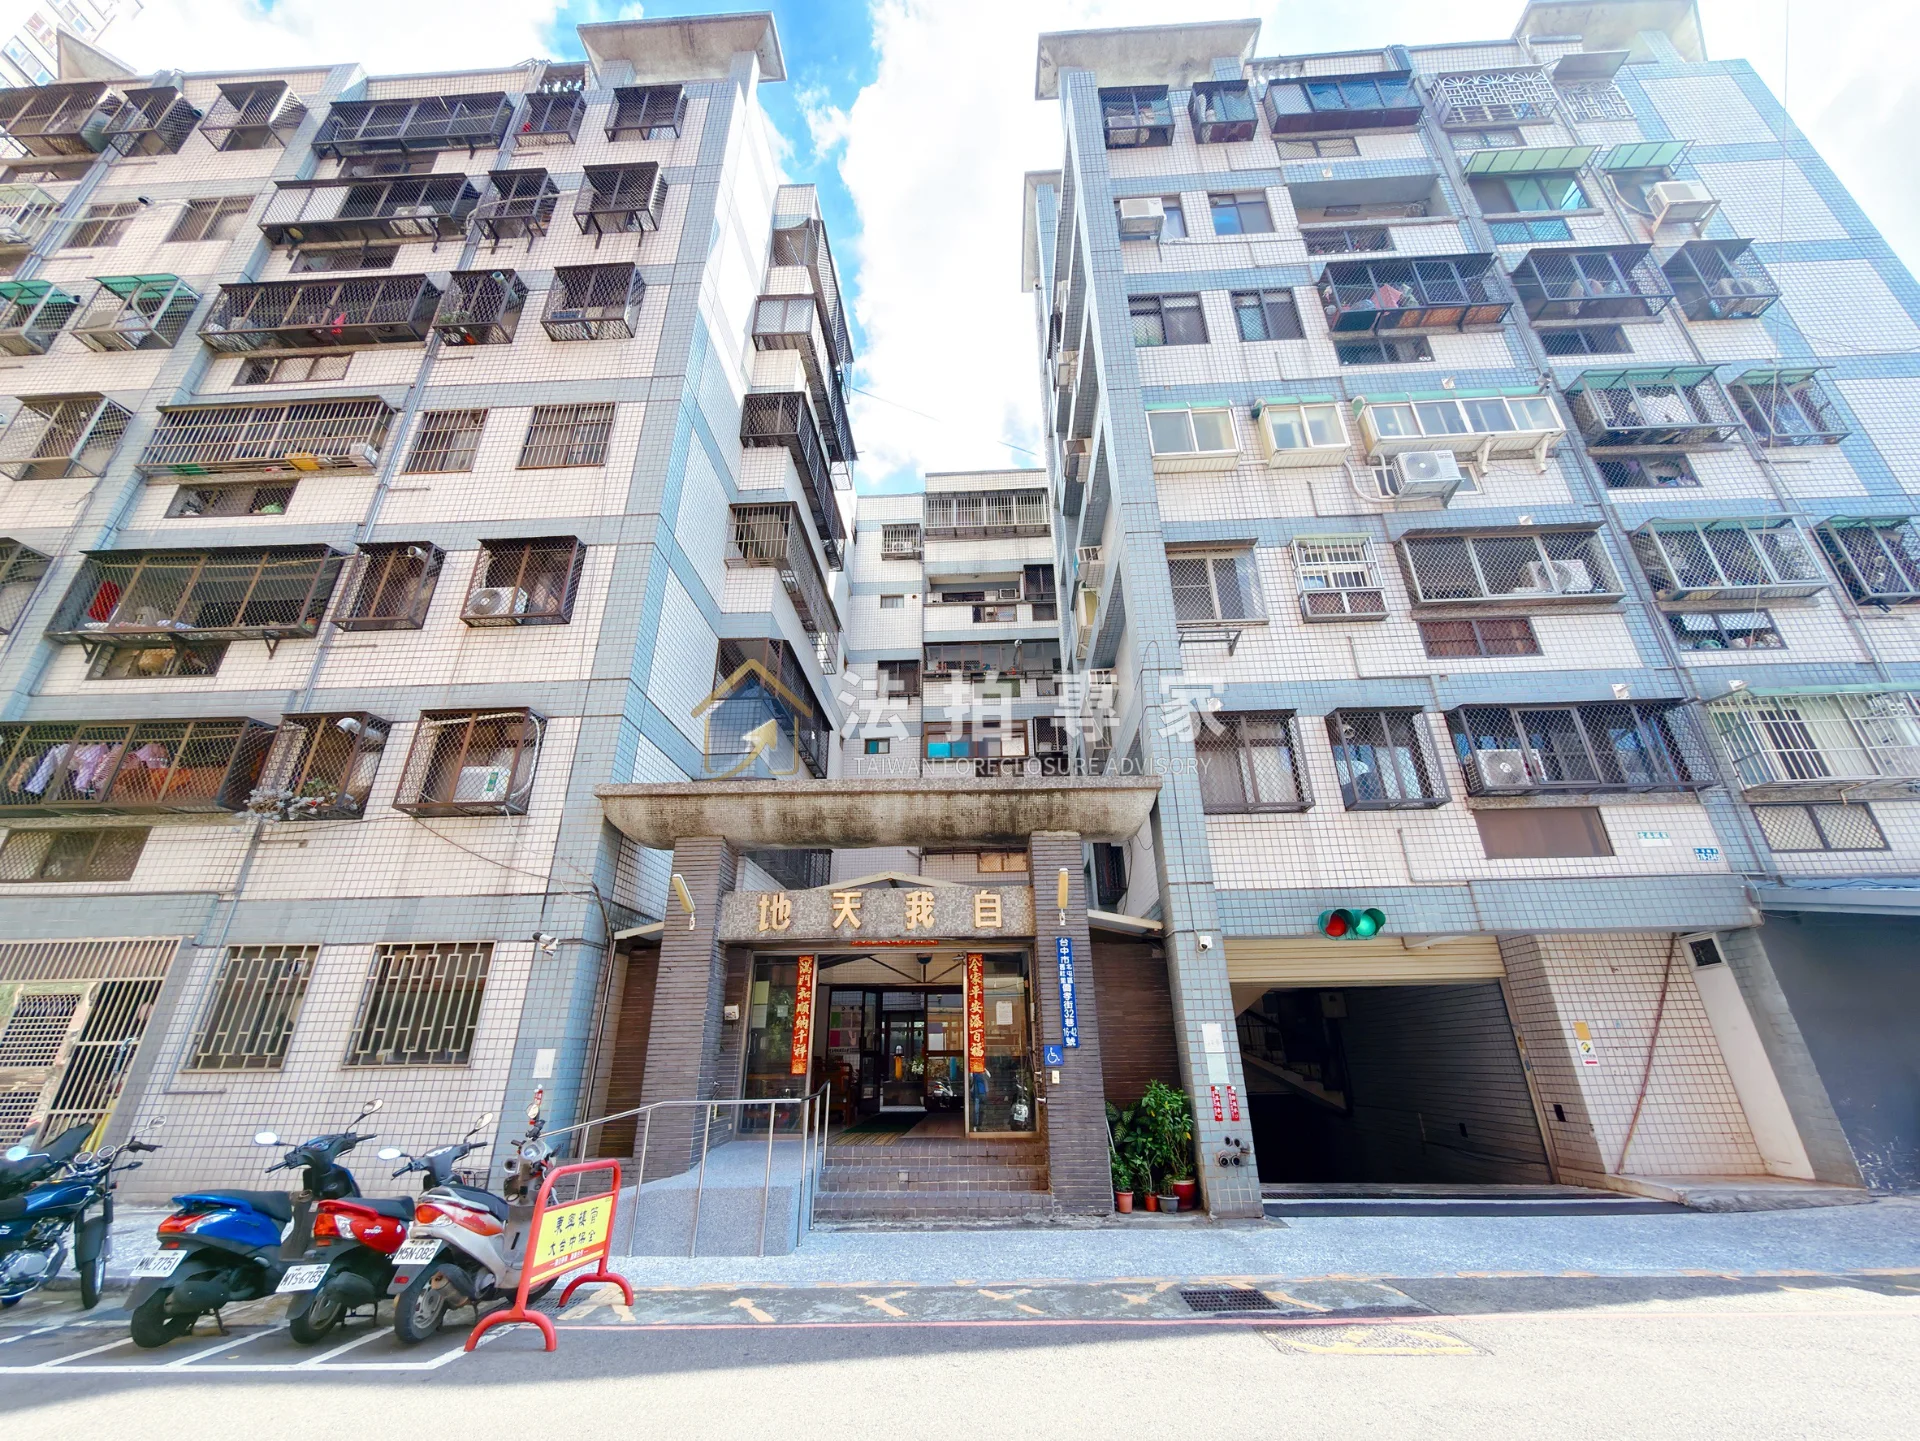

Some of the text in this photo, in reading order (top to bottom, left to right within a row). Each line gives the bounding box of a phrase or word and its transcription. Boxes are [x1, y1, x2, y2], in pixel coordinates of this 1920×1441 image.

[794, 960, 813, 1059] 滿門和順納千祥
[969, 958, 984, 1057] 全家平安添百福
